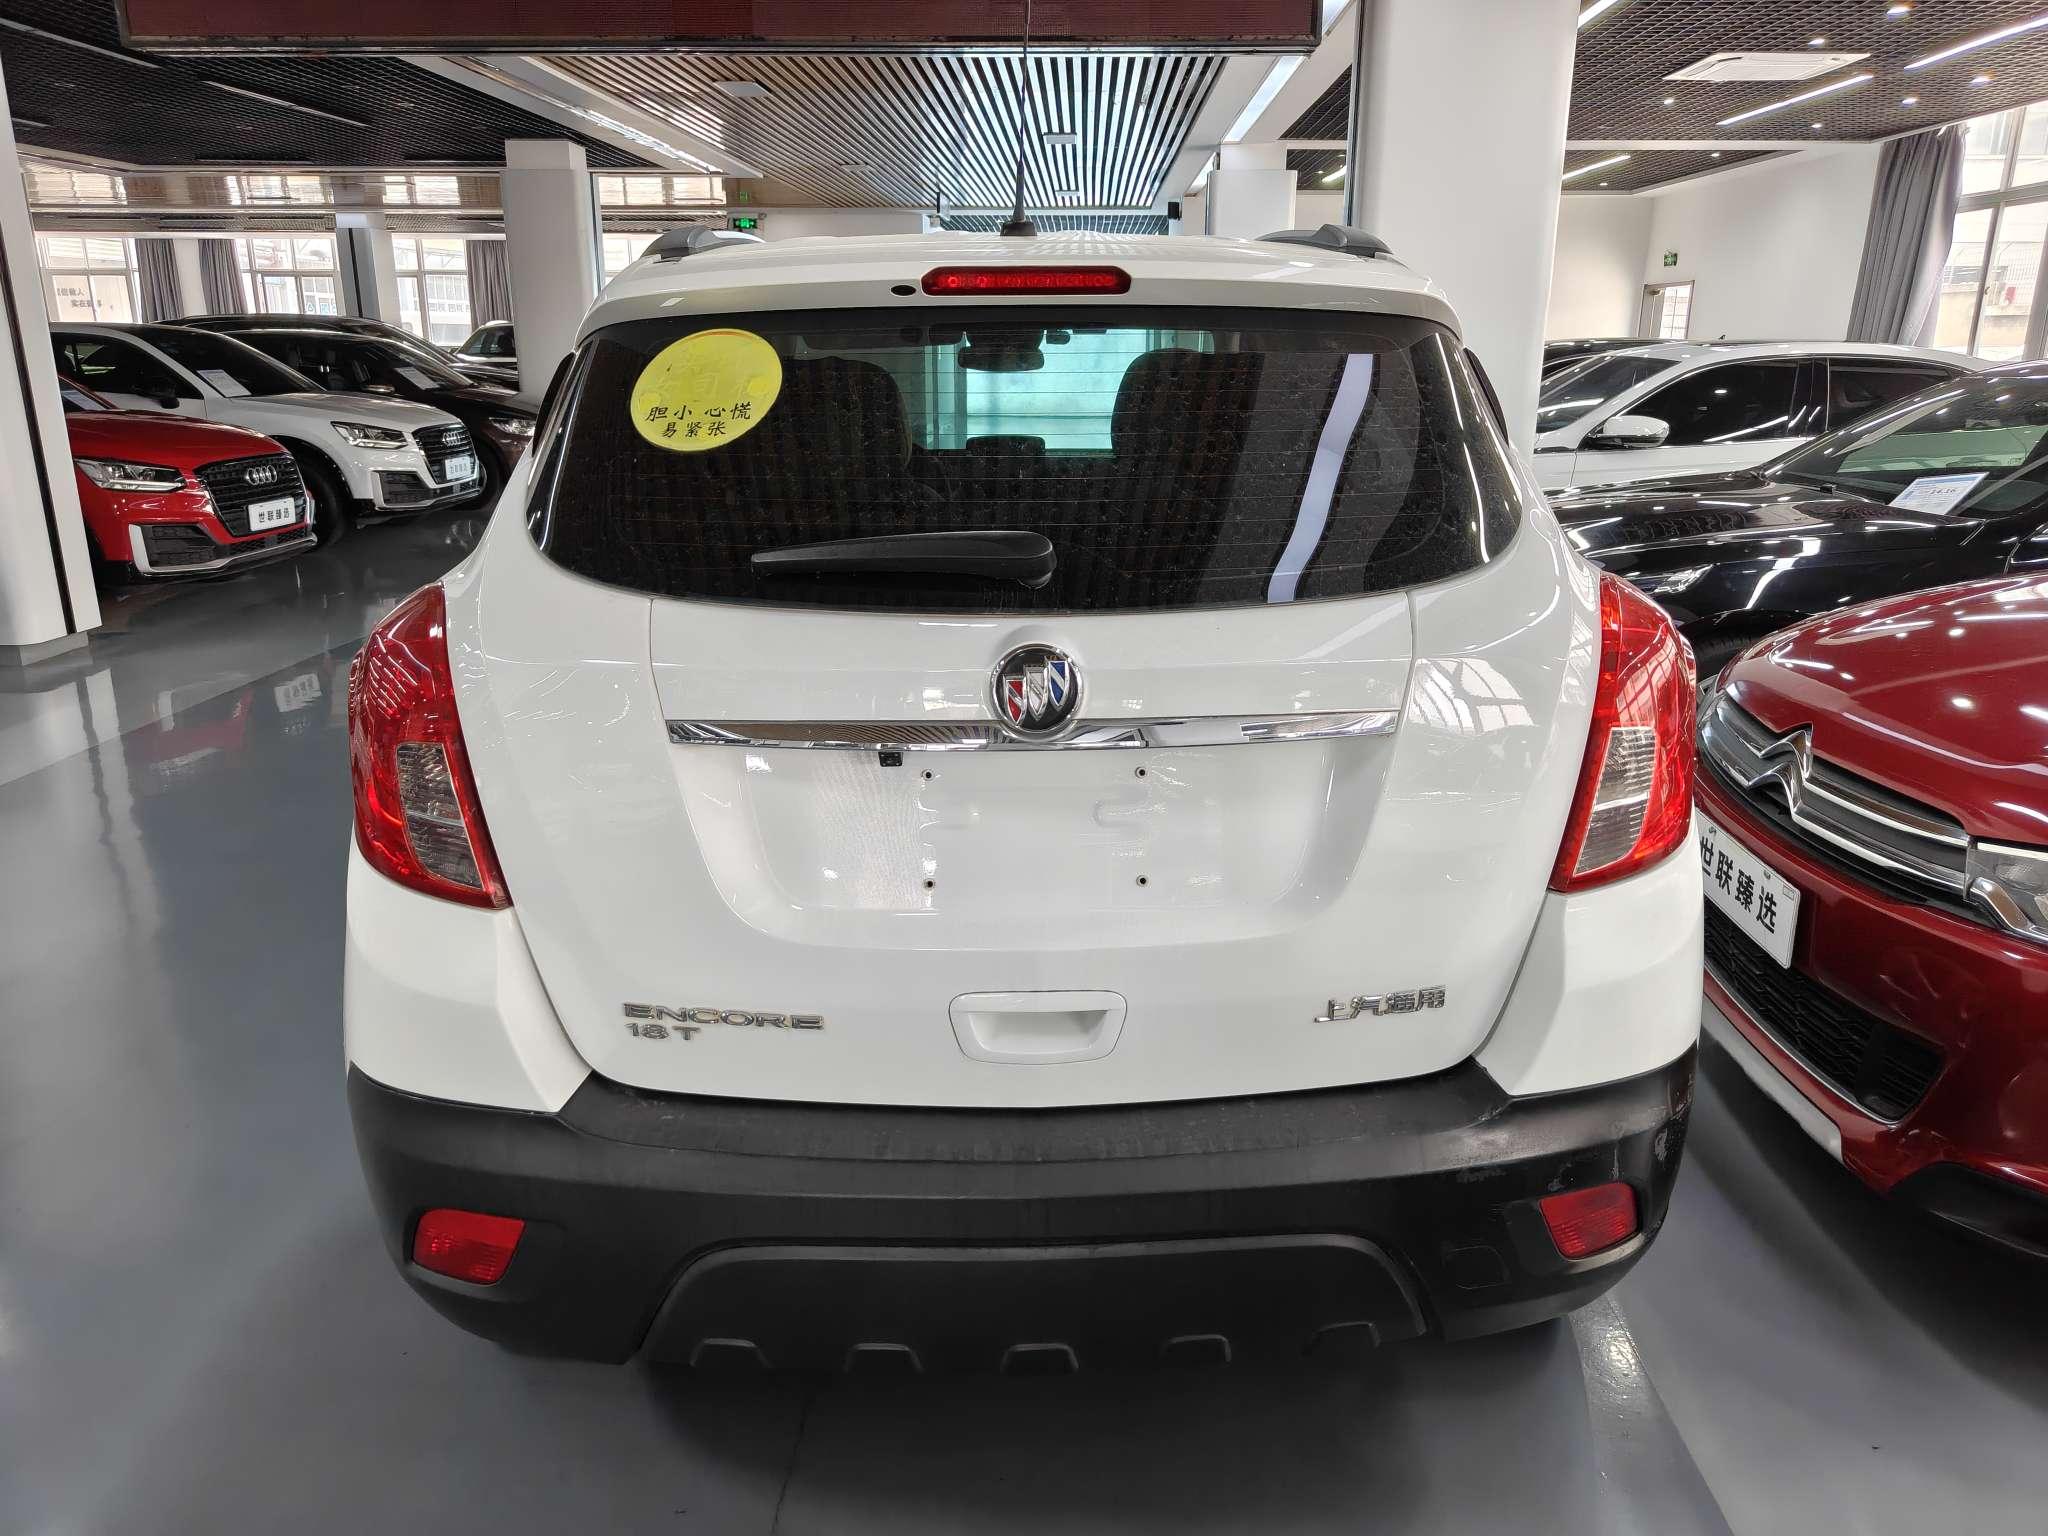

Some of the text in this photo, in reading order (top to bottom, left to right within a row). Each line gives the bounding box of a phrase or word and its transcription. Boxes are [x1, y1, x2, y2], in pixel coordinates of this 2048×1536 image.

[646, 401, 752, 422] 胆小心慌
[662, 421, 727, 438] 易紧张
[1313, 984, 1446, 1023] 上汽通用
[624, 1003, 825, 1030] ENCORE
